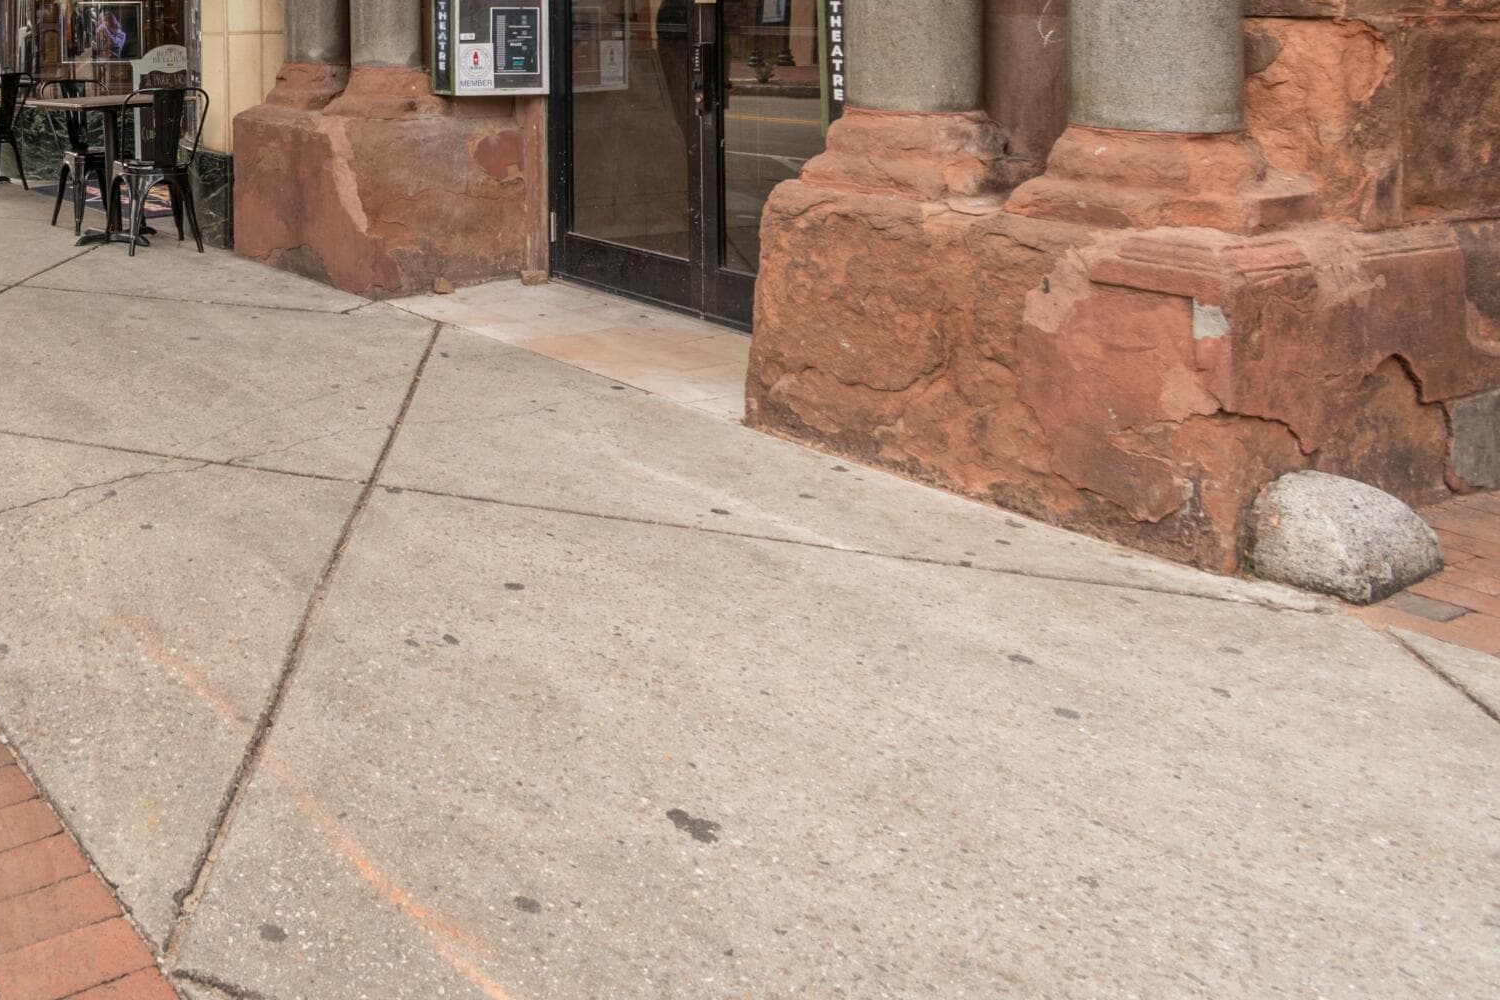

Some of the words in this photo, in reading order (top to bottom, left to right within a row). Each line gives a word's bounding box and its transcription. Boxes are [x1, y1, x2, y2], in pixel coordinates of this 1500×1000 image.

[438, 1, 447, 71] THEATRE
[829, 1, 844, 101] THEATRE
[460, 79, 492, 87] MEMBER
